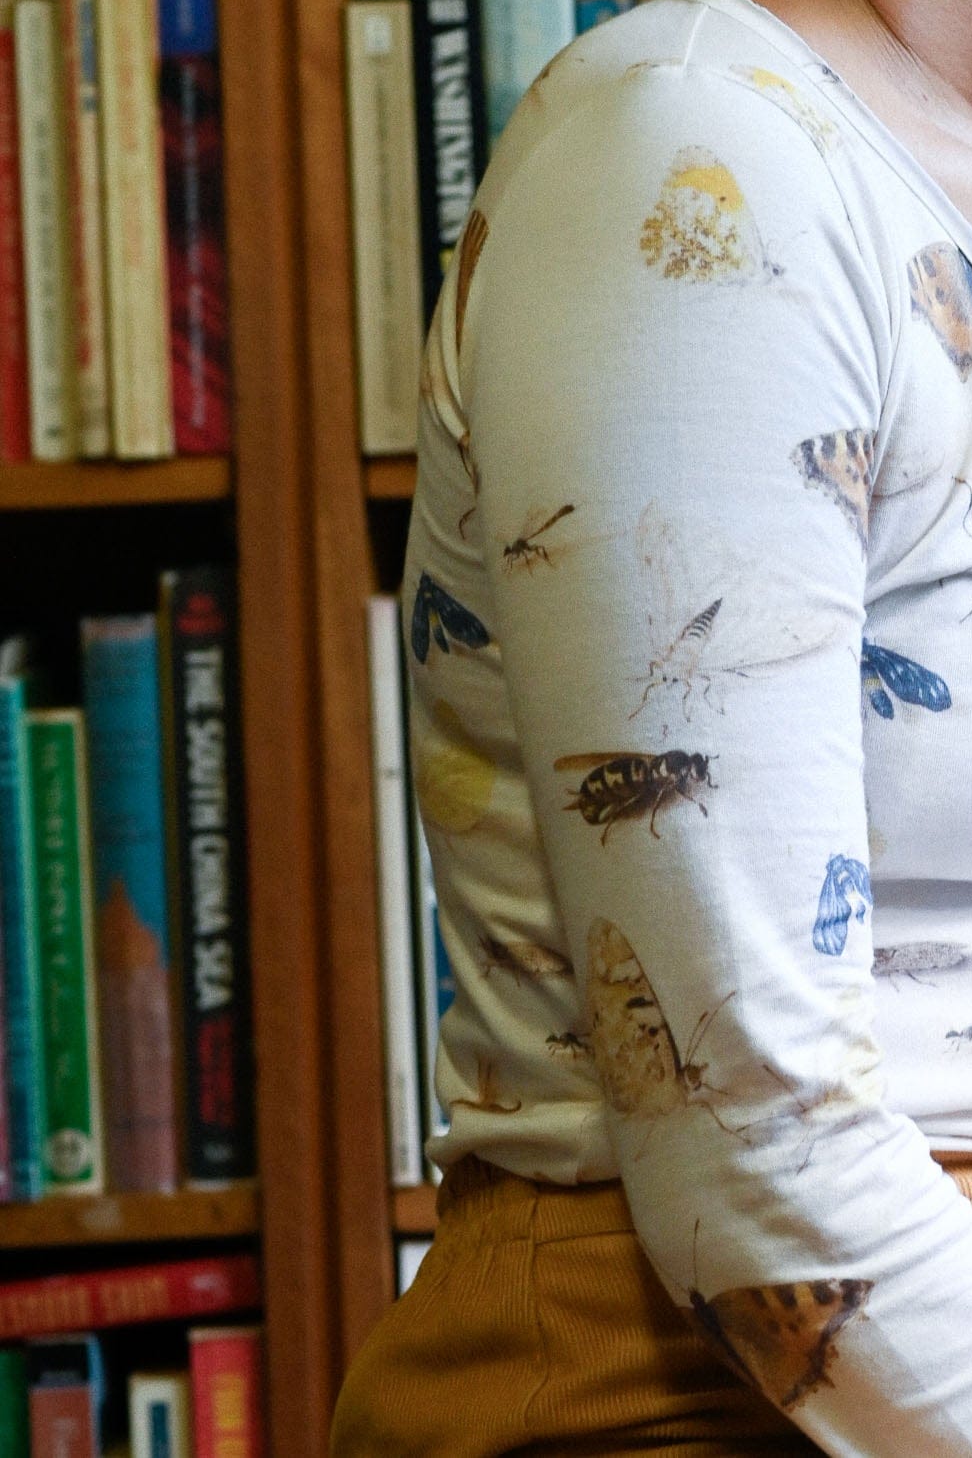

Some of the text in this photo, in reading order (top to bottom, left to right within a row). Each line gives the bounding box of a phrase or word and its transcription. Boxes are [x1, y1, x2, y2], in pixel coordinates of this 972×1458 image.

[183, 648, 224, 712] THE
[187, 718, 229, 829] SOUTH
[190, 835, 232, 935] CHINA
[195, 939, 234, 1012] SEA
